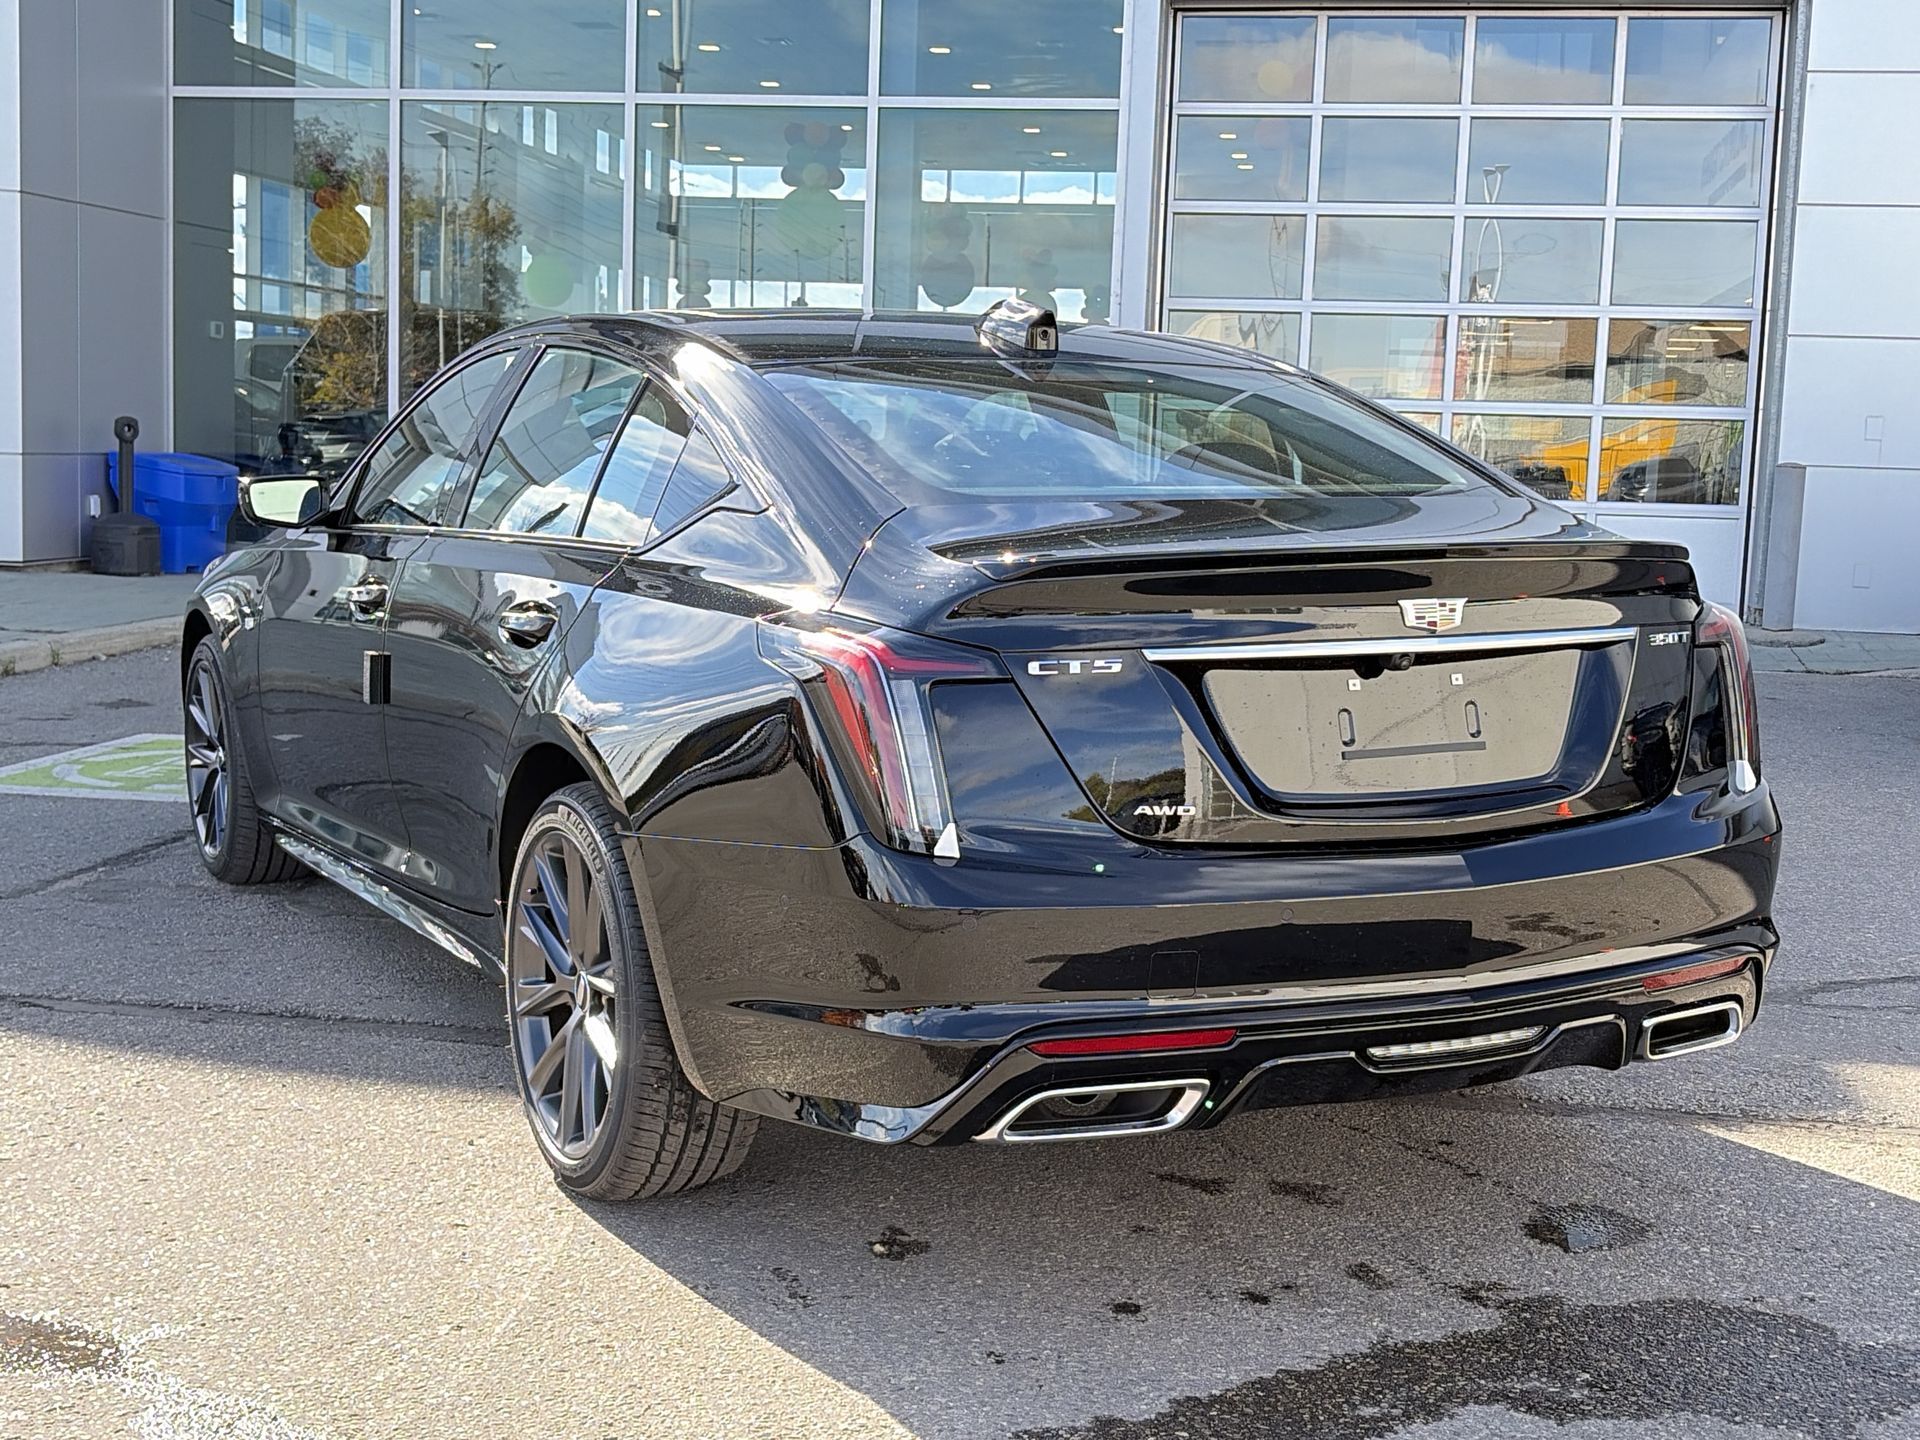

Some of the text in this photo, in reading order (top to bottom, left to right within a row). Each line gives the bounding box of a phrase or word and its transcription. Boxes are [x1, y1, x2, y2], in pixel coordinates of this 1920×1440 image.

[1648, 631, 1690, 646] 350T
[1027, 658, 1123, 675] CT5
[1133, 805, 1196, 816] AWD
[567, 811, 602, 873] MICHELIN
